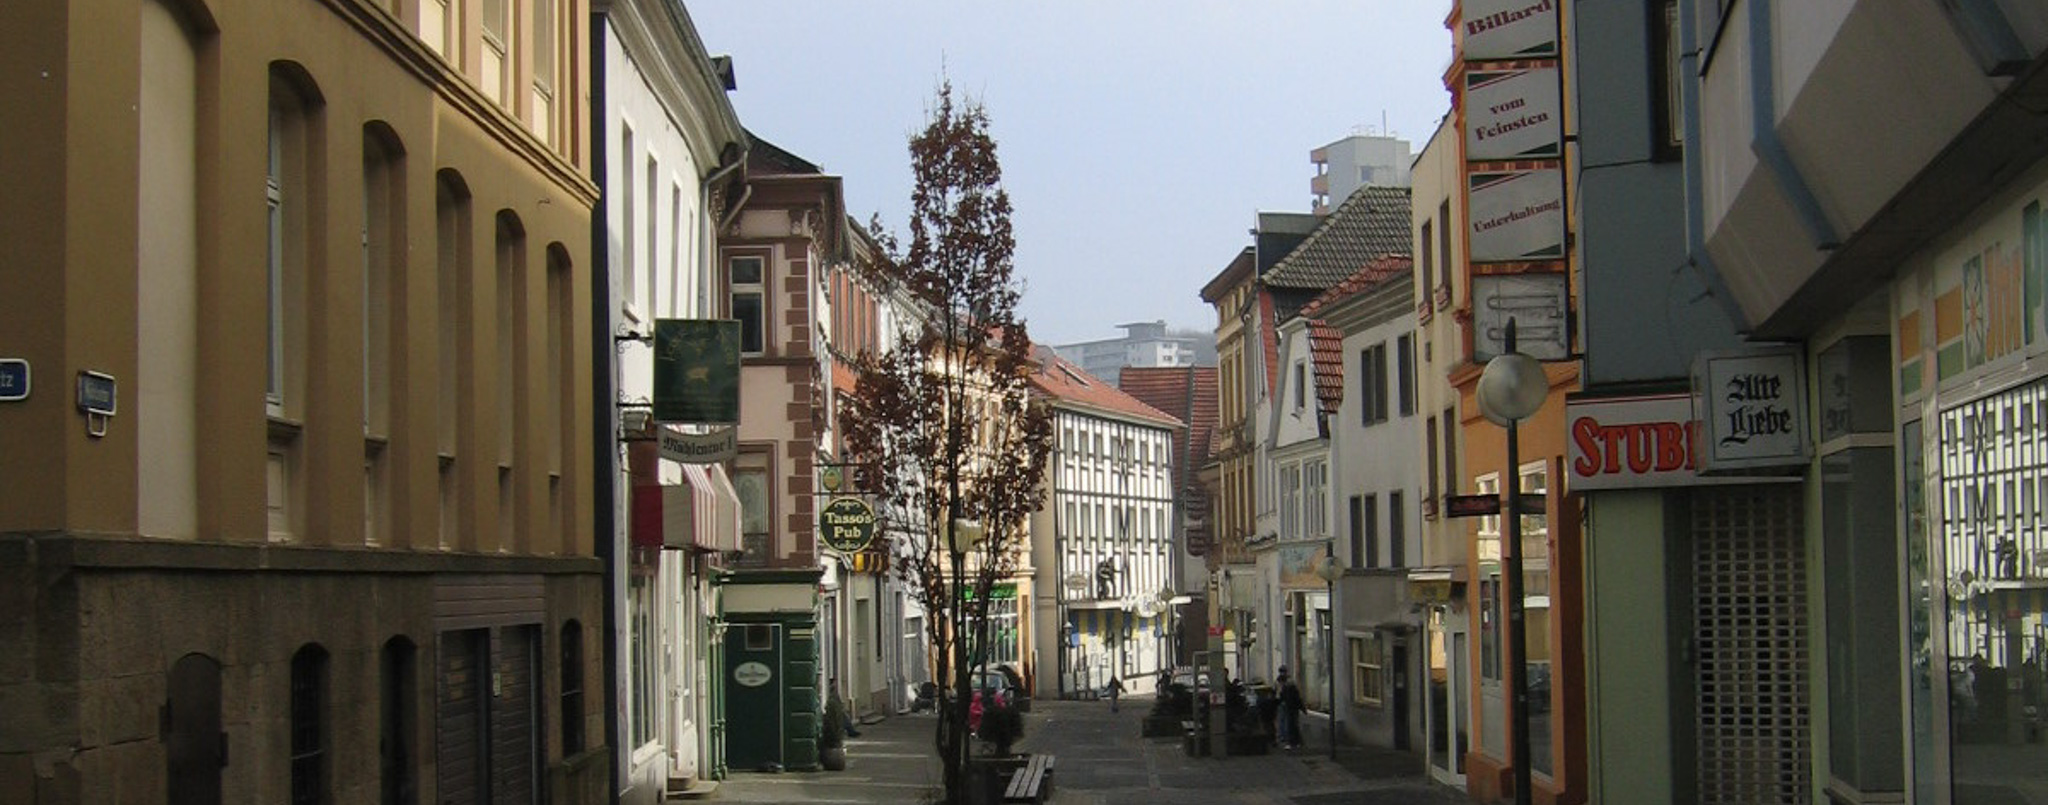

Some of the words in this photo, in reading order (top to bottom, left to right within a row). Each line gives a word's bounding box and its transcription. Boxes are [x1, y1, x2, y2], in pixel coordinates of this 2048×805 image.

[1467, 0, 1551, 35] Billard
[1489, 98, 1526, 114] vom
[1475, 111, 1549, 142] Feinsten
[1473, 199, 1561, 233] Unterhaltung
[1726, 372, 1782, 404] Alte
[1720, 405, 1792, 447] Liebe
[833, 526, 862, 539] Pub
